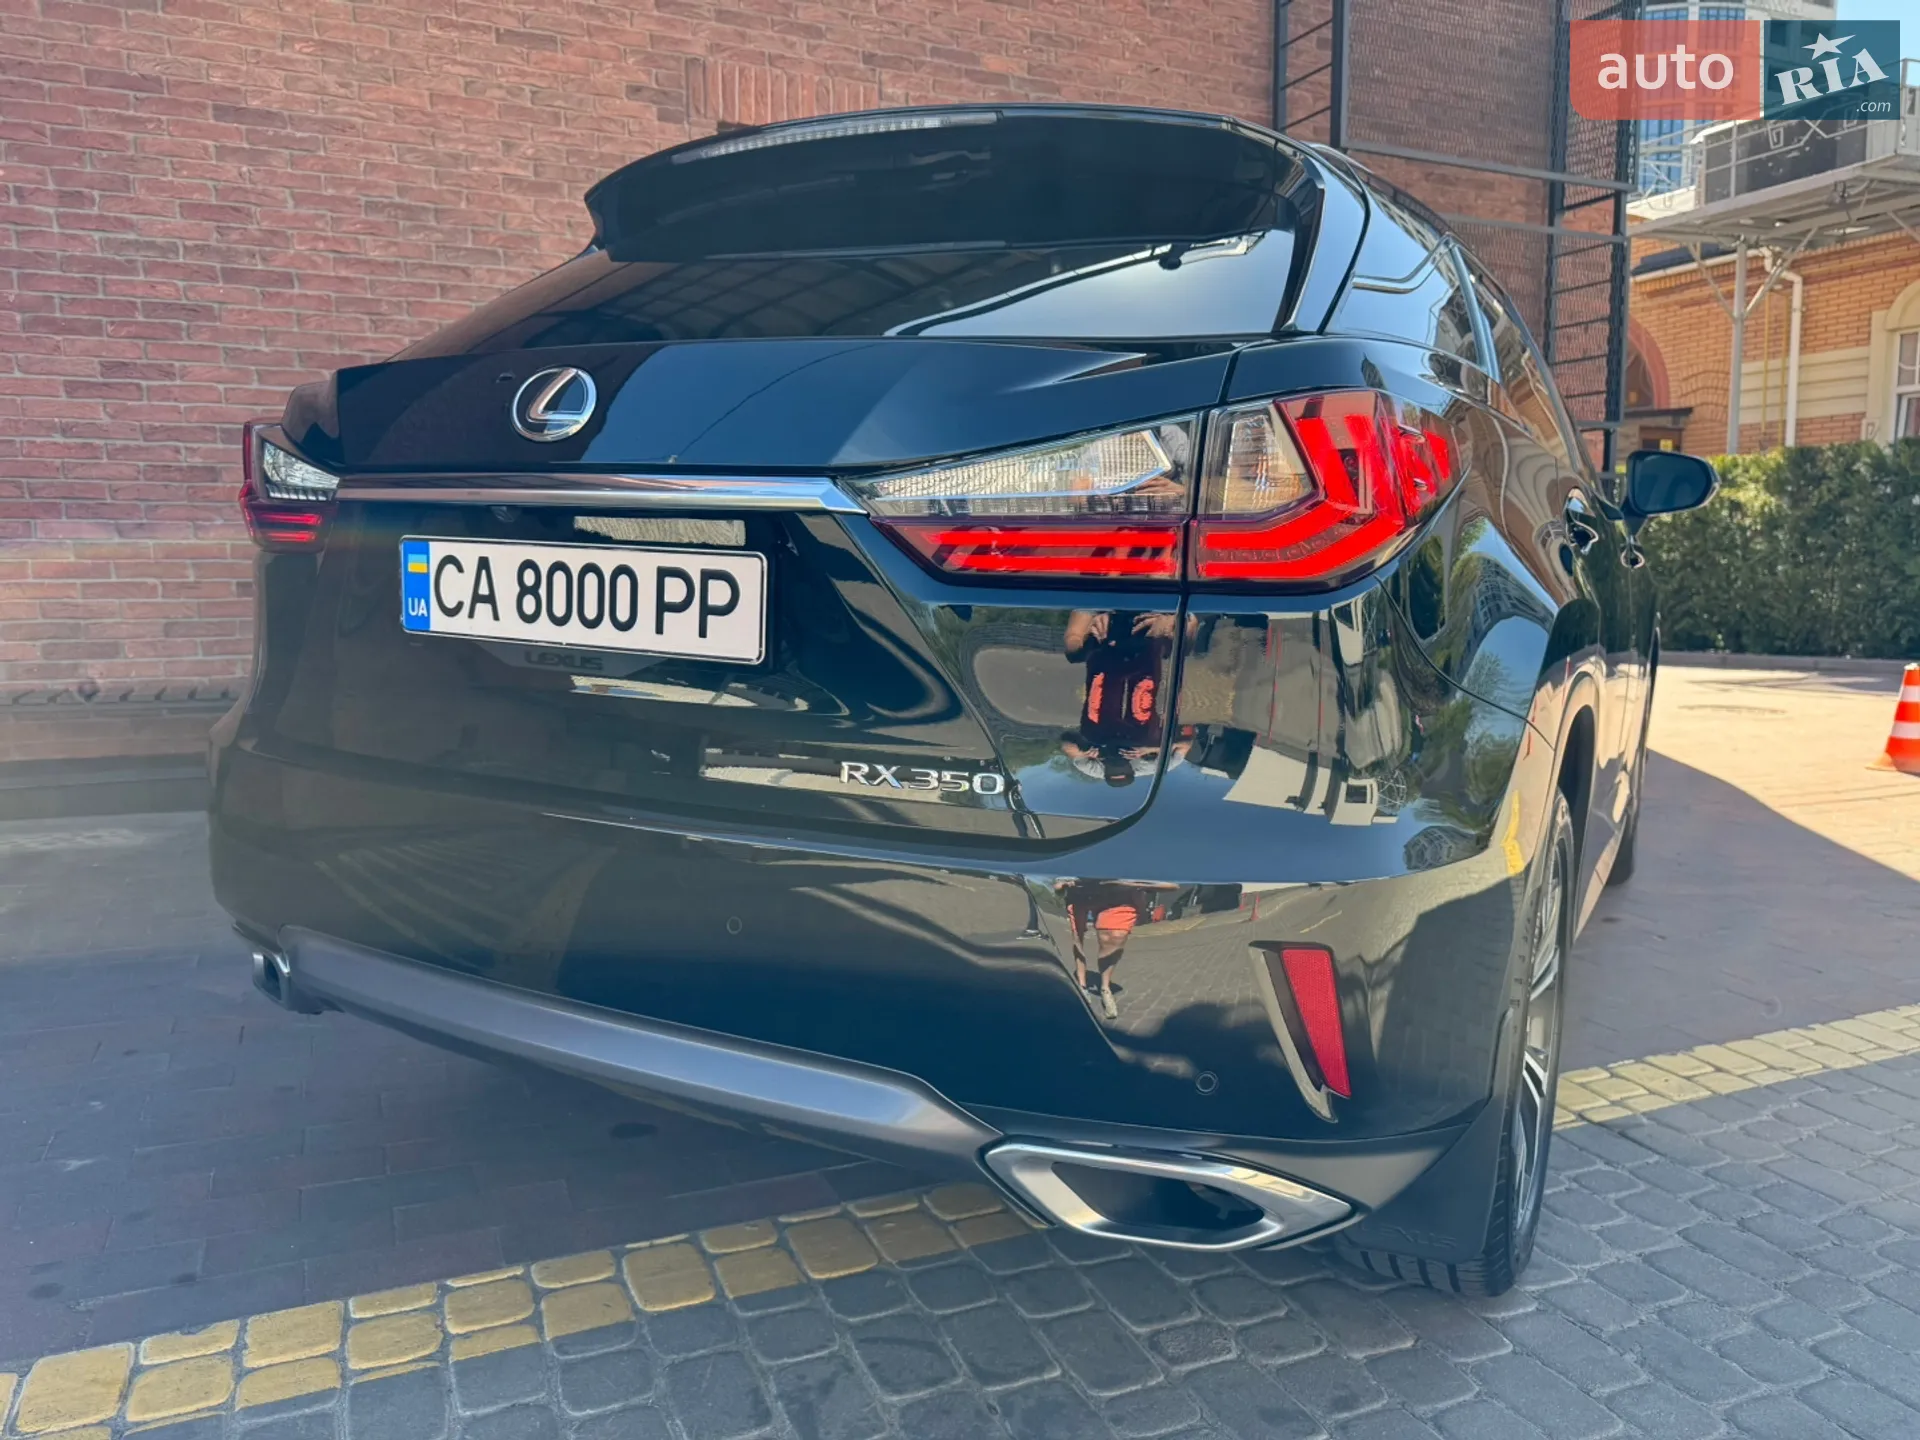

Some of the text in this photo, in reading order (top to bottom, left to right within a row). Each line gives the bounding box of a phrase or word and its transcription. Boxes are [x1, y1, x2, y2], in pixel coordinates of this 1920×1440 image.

[408, 597, 428, 617] UA
[434, 555, 740, 639] CA 8000 PP
[524, 650, 604, 671] LEXUS
[840, 761, 1005, 795] RX 350
